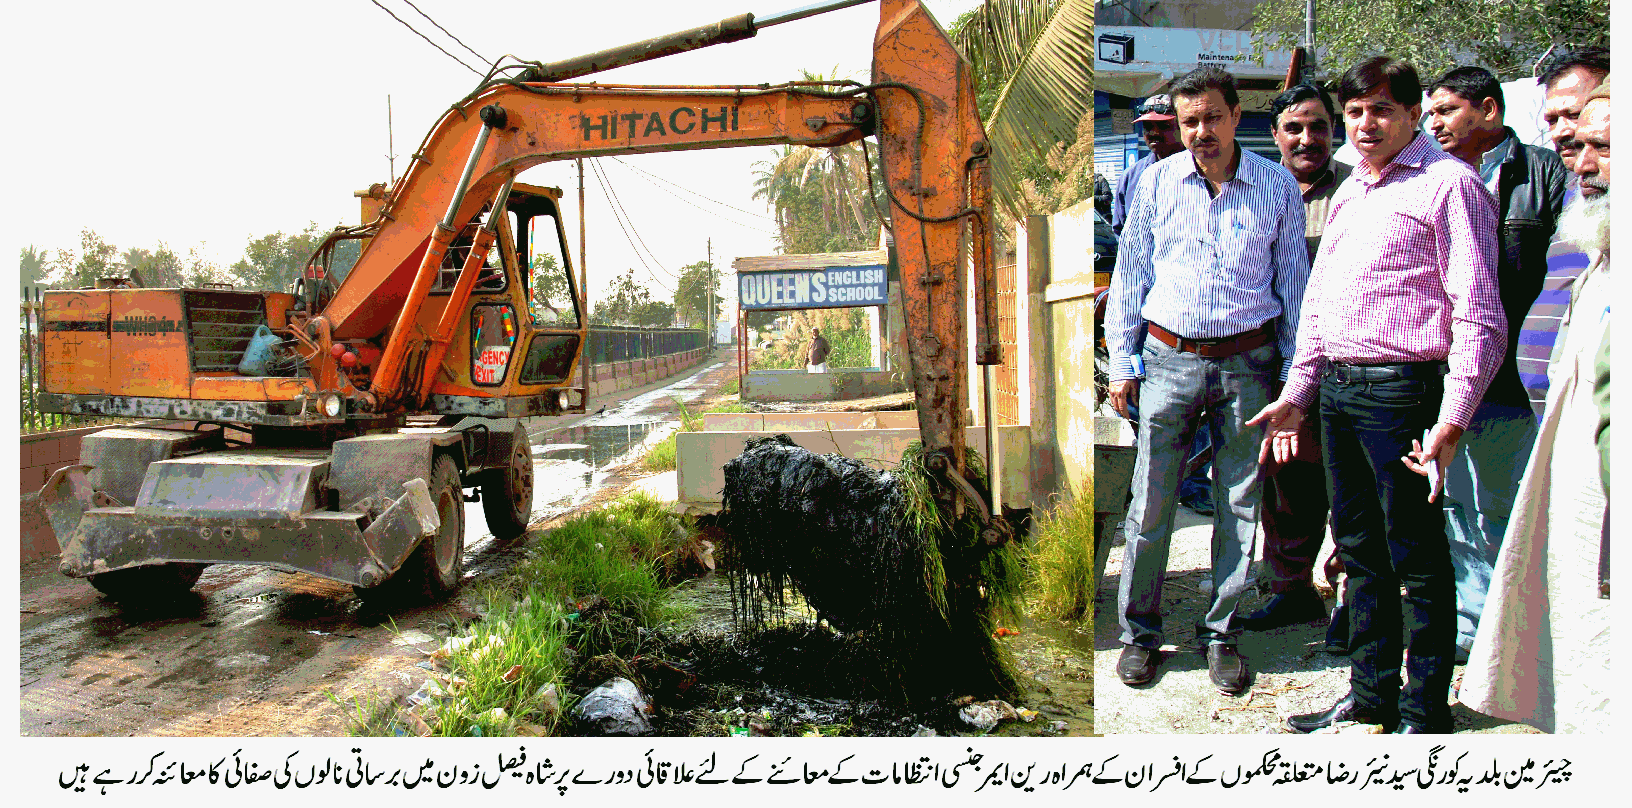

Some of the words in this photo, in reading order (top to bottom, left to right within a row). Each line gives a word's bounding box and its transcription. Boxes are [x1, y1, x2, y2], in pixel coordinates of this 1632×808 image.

[581, 106, 739, 141] HITACHI
[741, 272, 826, 305] QUEEN'S
[828, 269, 883, 285] ENGLISH
[828, 286, 883, 302] SCHOOL
